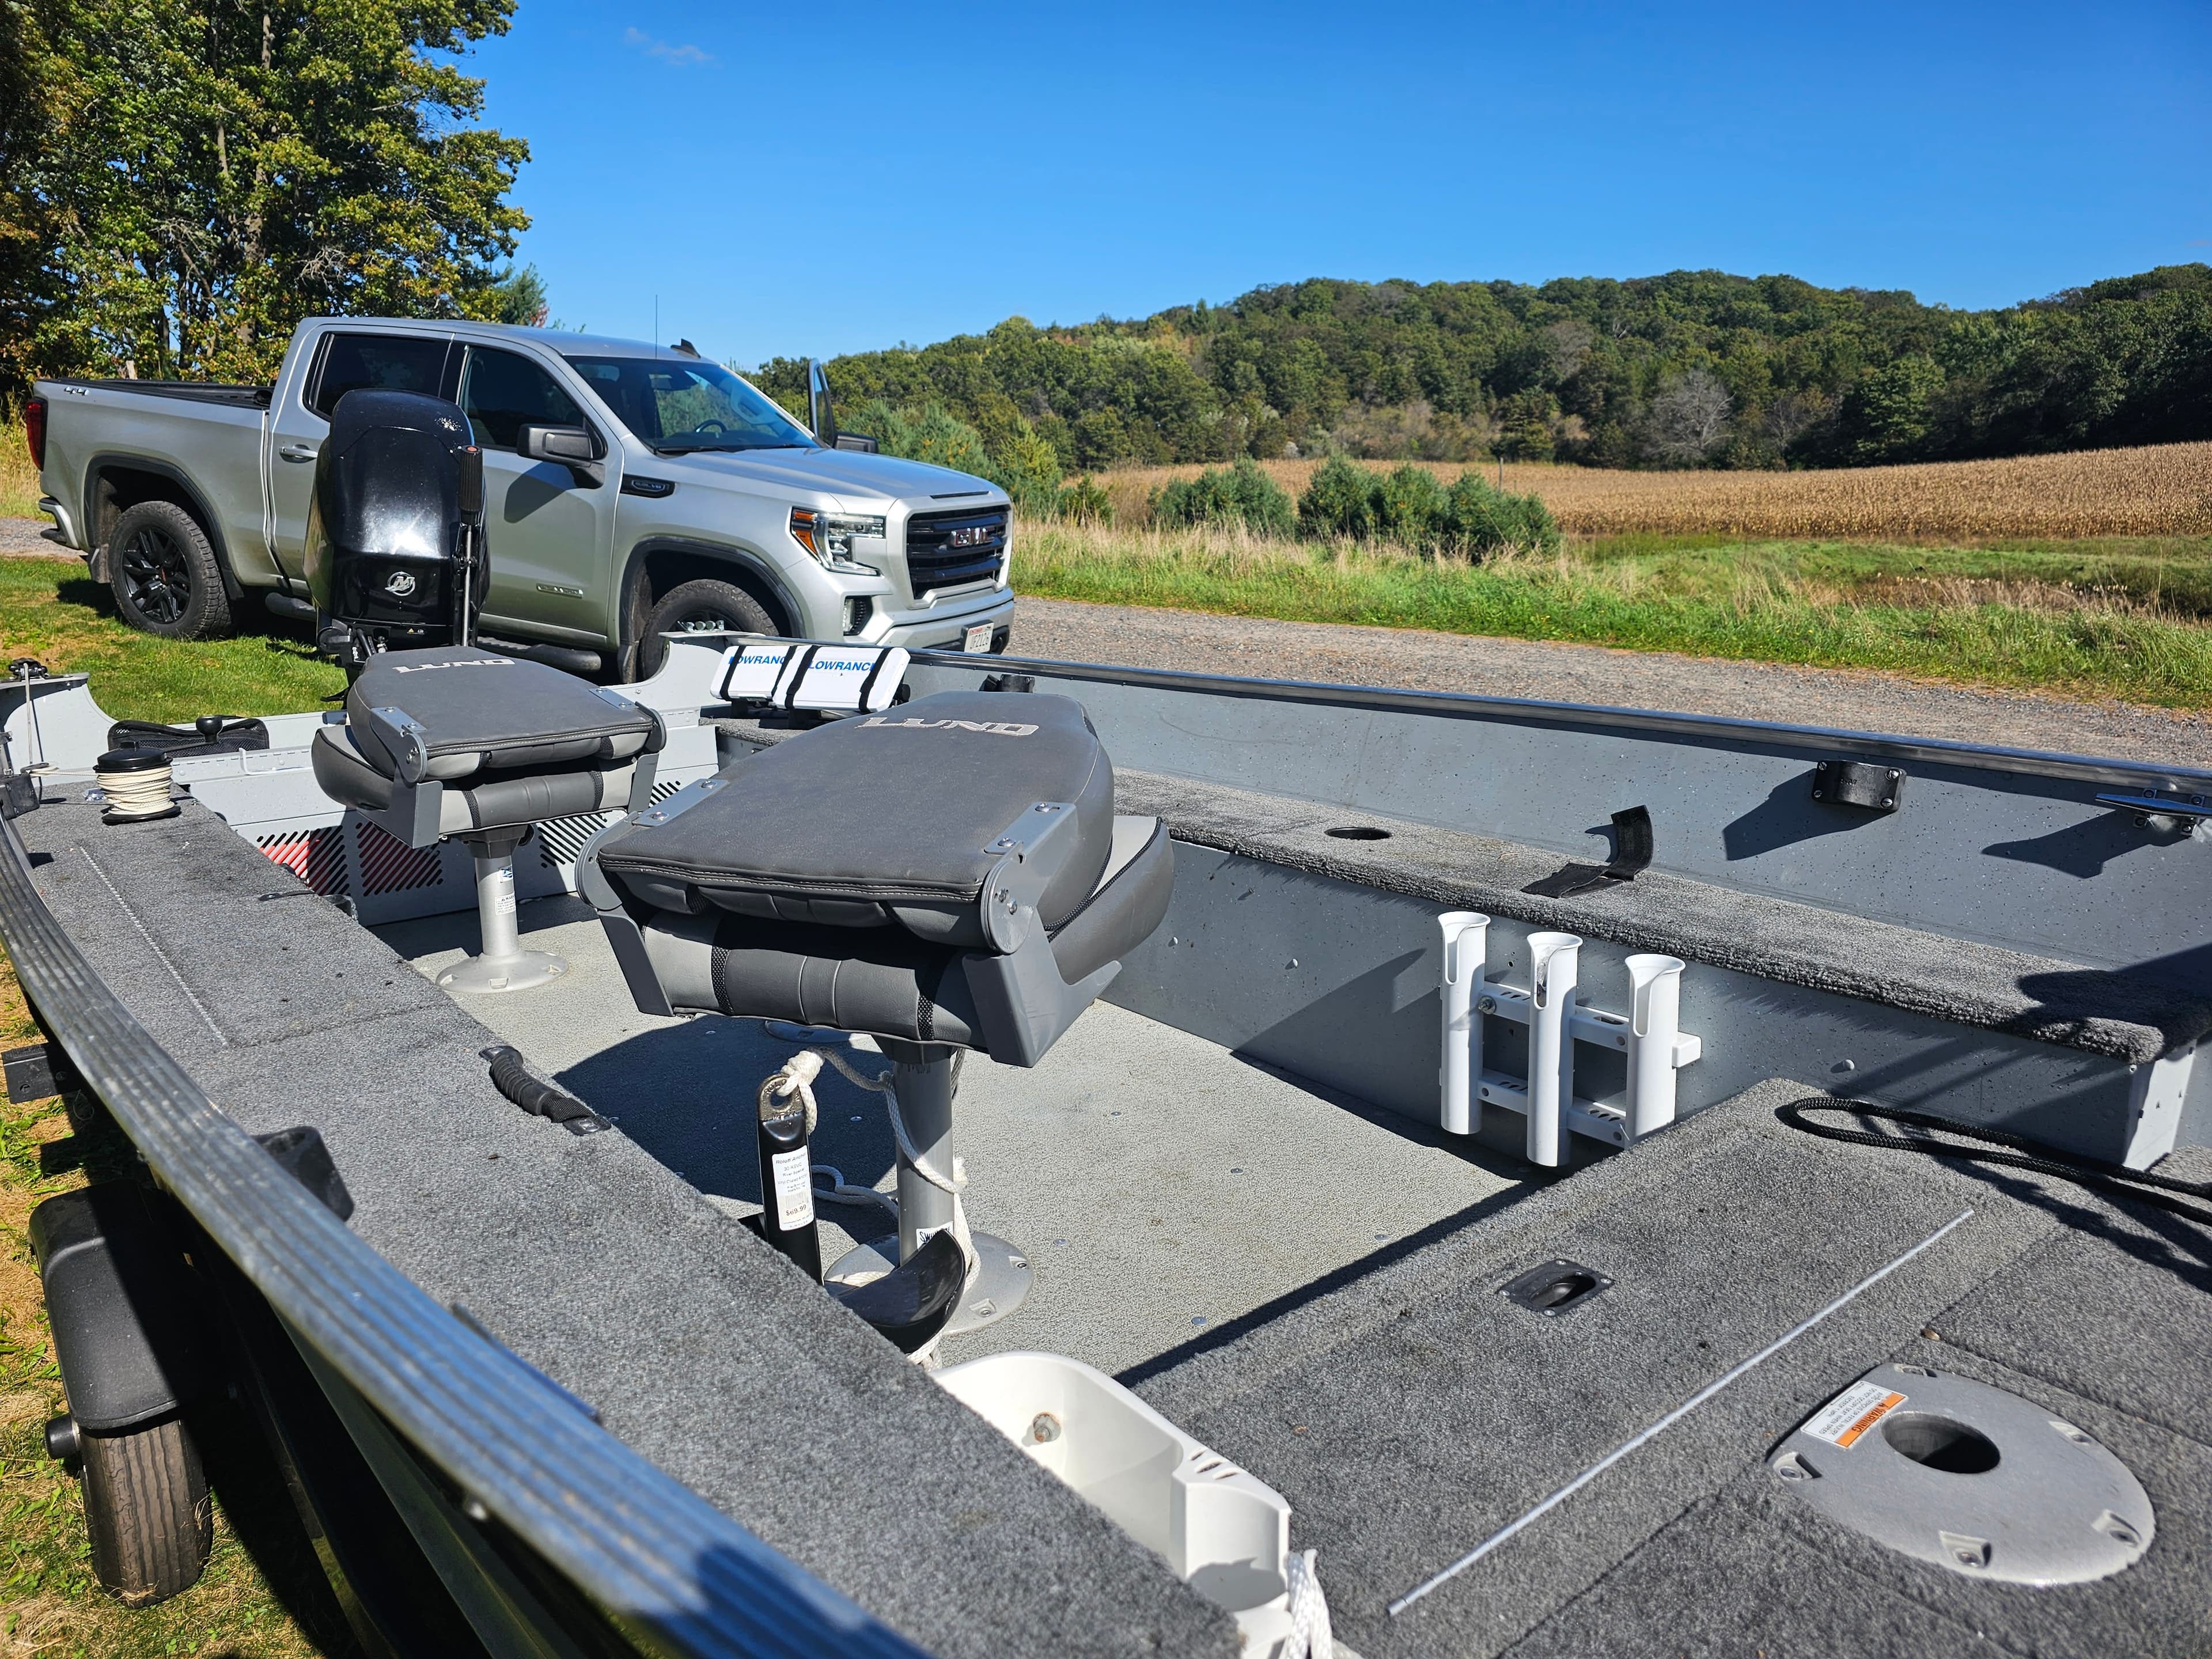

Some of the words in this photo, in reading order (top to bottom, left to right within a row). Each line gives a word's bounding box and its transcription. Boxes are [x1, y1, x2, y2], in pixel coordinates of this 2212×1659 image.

[951, 527, 995, 547] GMC
[392, 659, 516, 673] LUND
[728, 656, 786, 664] LOWRANC
[855, 717, 1039, 737] LUND
[786, 1204, 806, 1216] $69.99
[1851, 1406, 1887, 1433] WARNING
